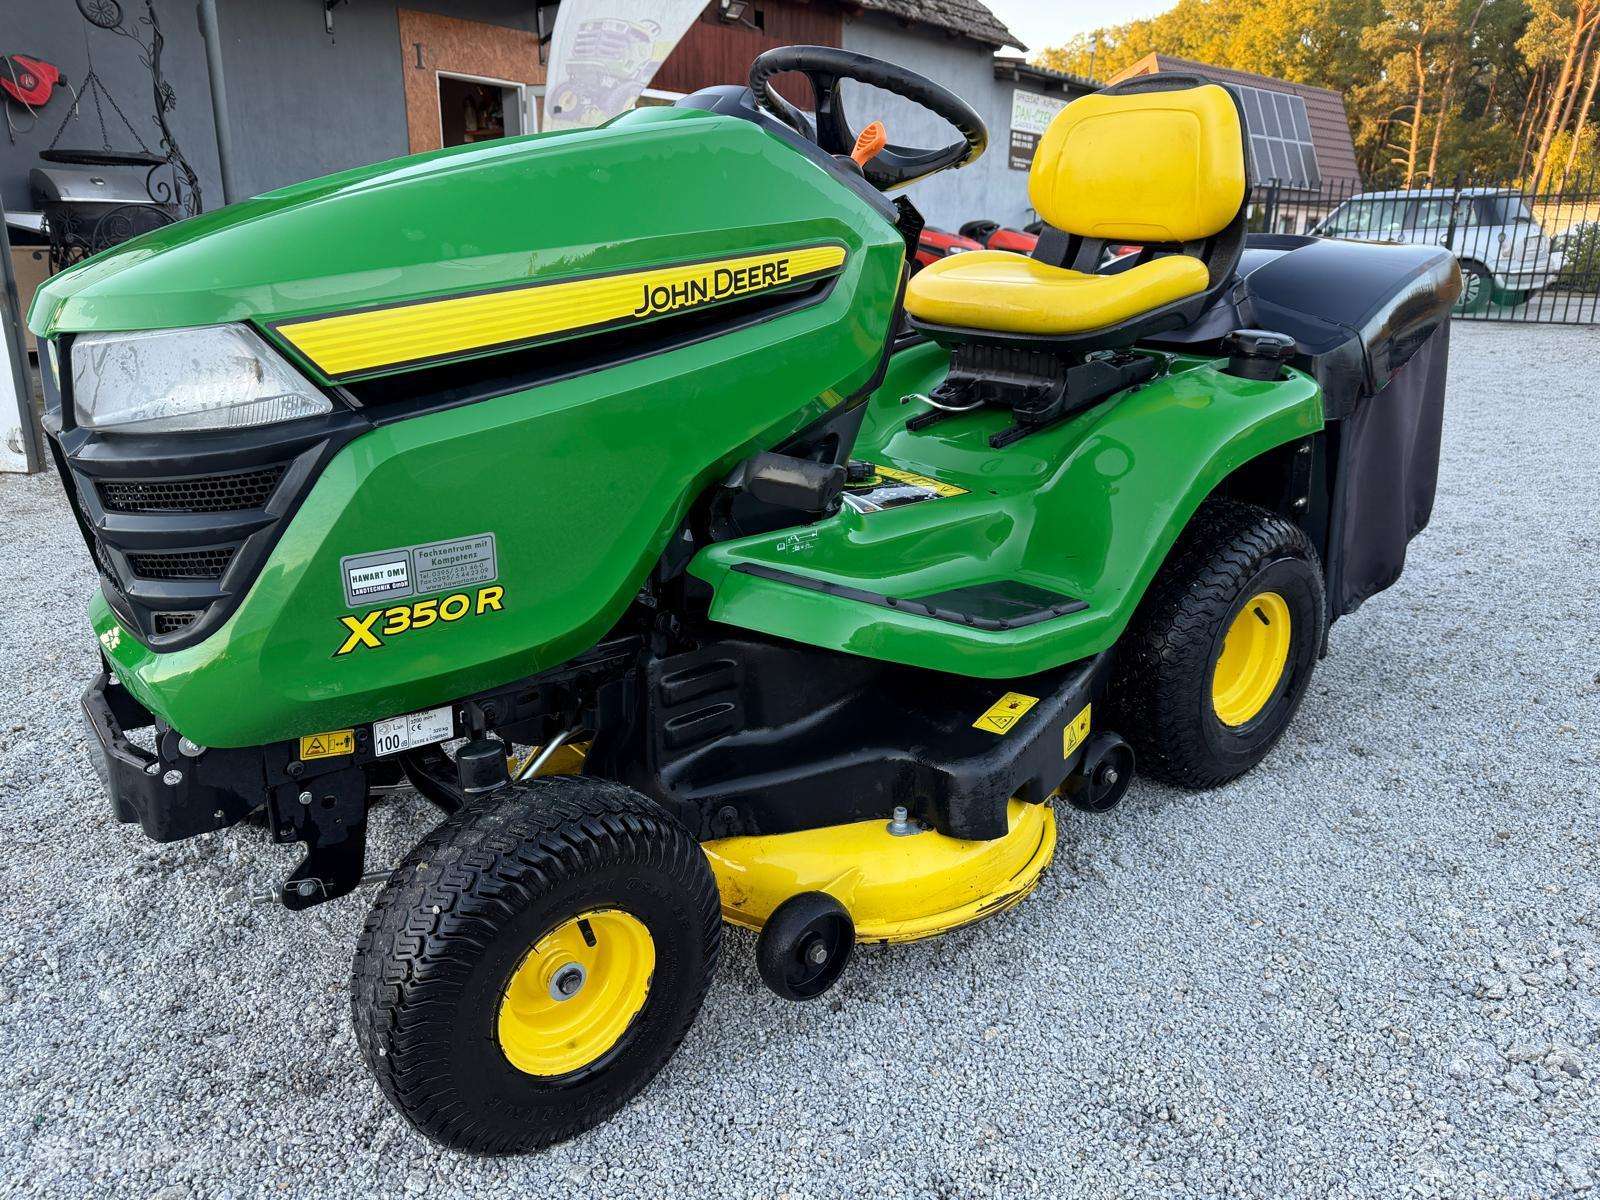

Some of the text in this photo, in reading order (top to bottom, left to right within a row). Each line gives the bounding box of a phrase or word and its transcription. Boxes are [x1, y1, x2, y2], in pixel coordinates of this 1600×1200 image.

[634, 258, 790, 316] JOHN DEERE
[419, 541, 488, 559] Fachzentrum mit
[431, 552, 478, 566] Kompetenz
[352, 567, 405, 584] HAWART OMV
[352, 583, 390, 596] LANDTECHNIK
[377, 734, 400, 753] 100
